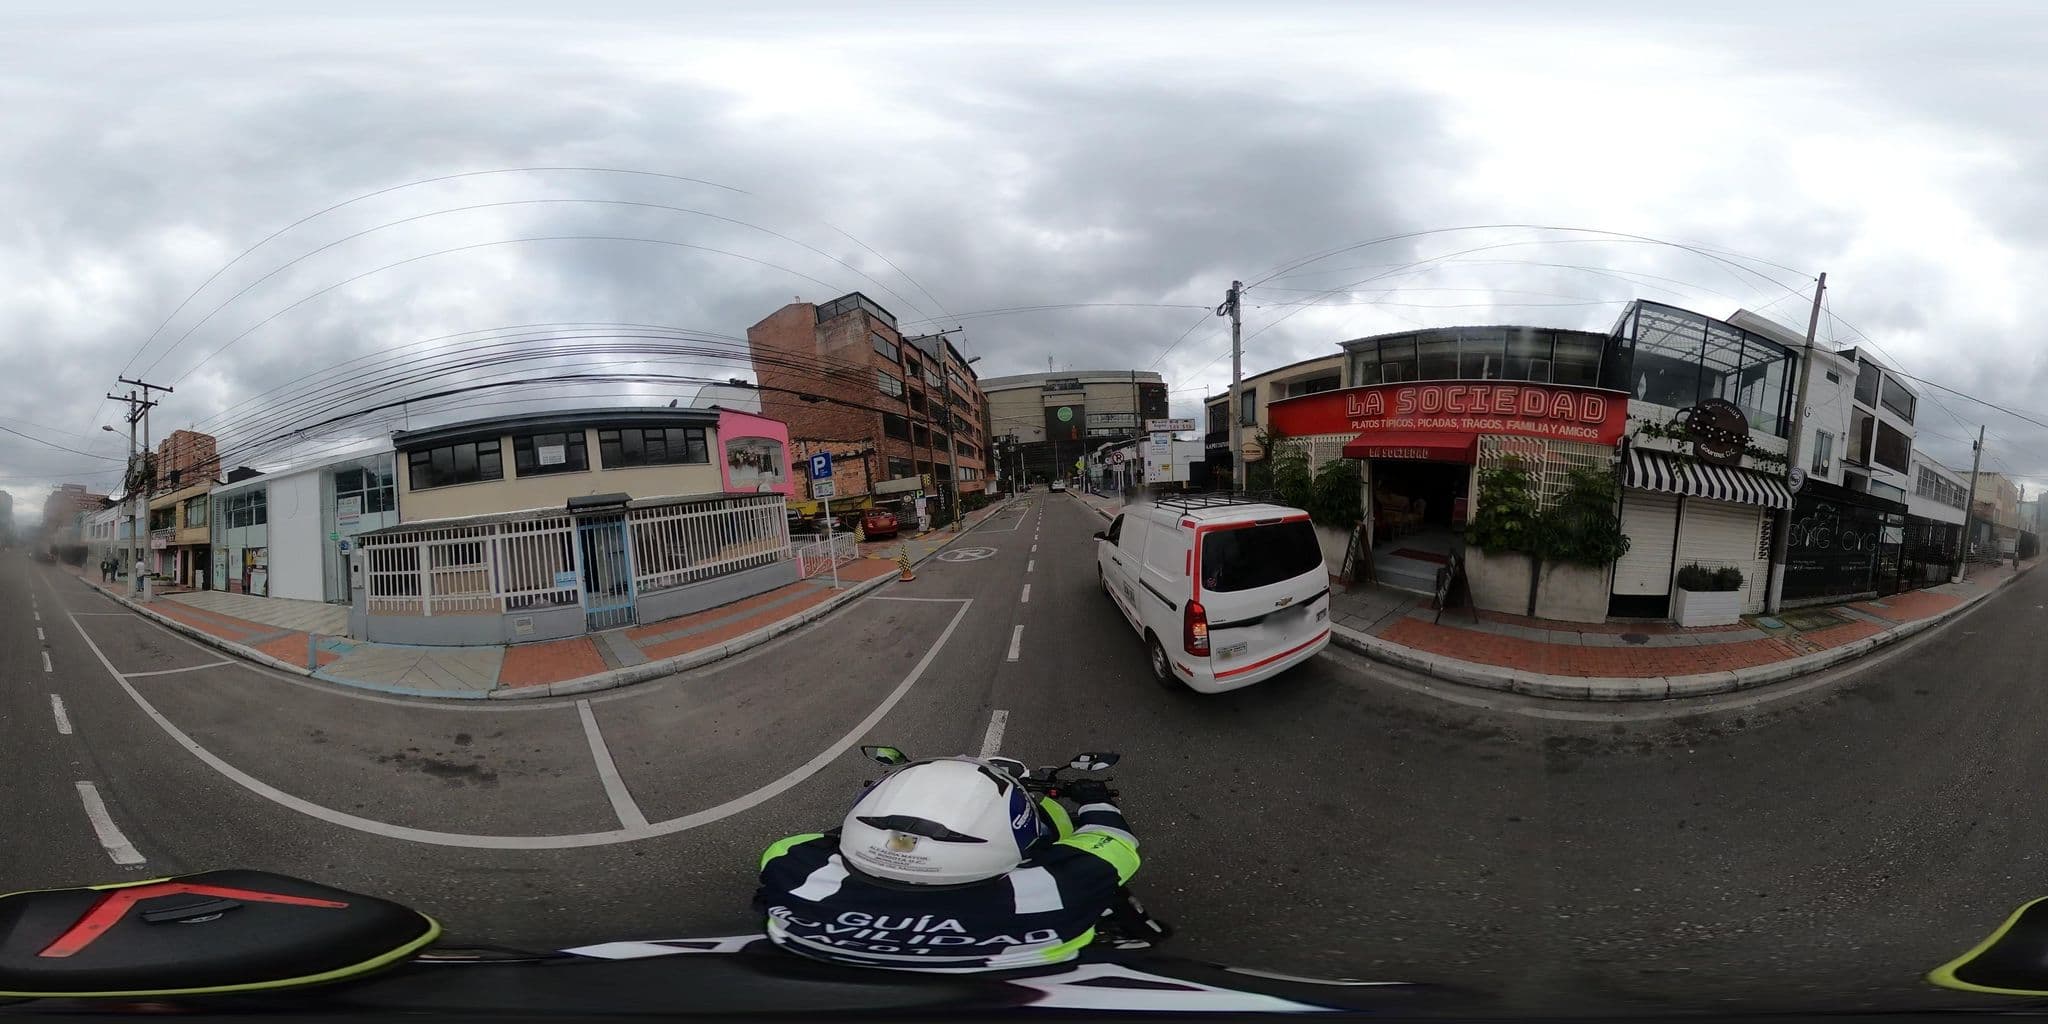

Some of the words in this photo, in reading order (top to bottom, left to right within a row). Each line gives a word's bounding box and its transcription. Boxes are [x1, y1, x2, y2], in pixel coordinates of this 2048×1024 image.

[1346, 390, 1384, 417] LA
[1396, 385, 1607, 423] SOCIEDAD
[1352, 419, 1379, 429] PLATOS
[1381, 417, 1416, 429] TÍPICOS,
[1418, 419, 1459, 429] PICADAS,
[1462, 419, 1504, 430] TRAGOS,
[1506, 420, 1550, 433] FAMILIA
[1550, 424, 1557, 433] Y
[1559, 426, 1598, 438] AMIGOS
[813, 456, 826, 476] P
[837, 911, 967, 933] GUÍA
